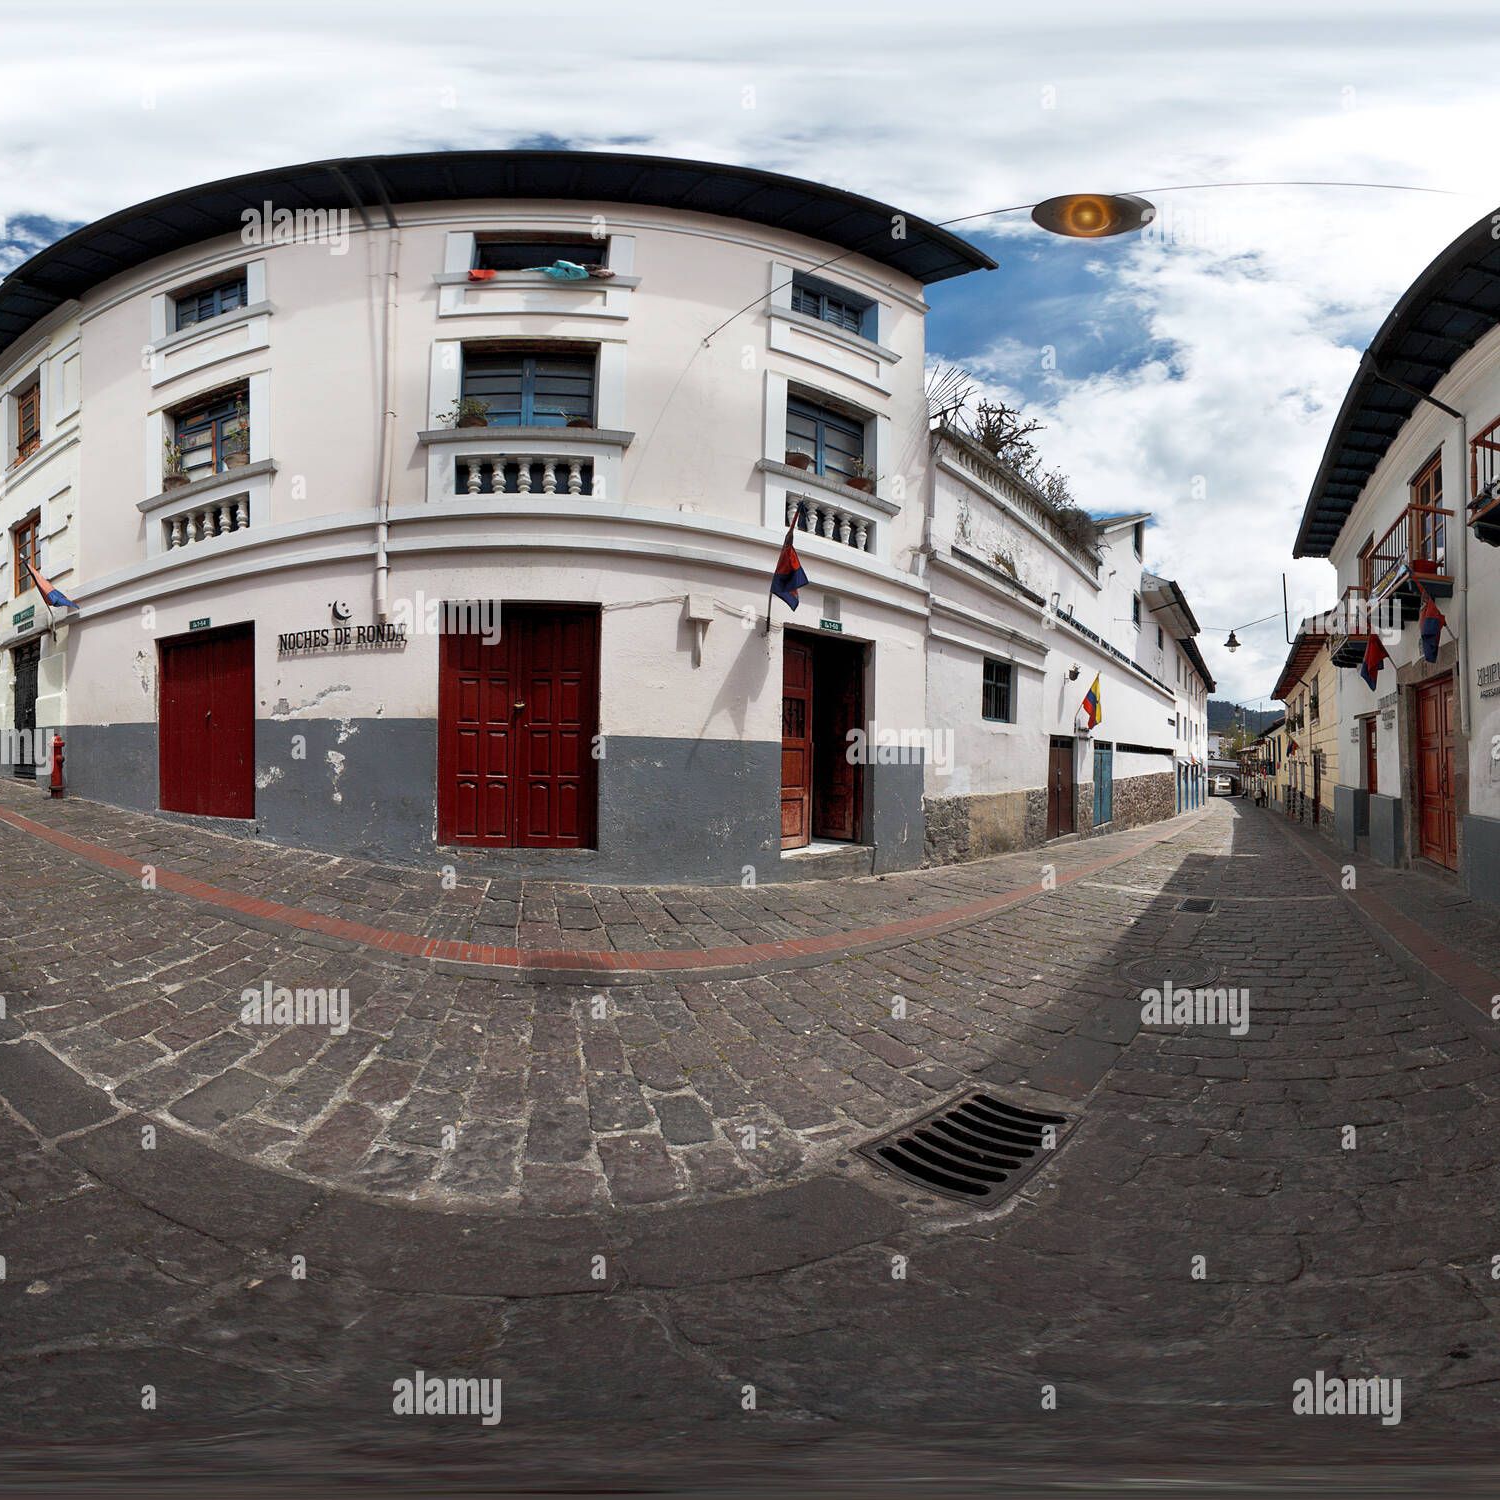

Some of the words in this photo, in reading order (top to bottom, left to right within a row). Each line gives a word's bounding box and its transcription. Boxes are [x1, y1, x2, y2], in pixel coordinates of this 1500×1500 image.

[278, 629, 329, 651] NOCHES
[334, 626, 352, 645] DE
[357, 623, 407, 643] RONDA
